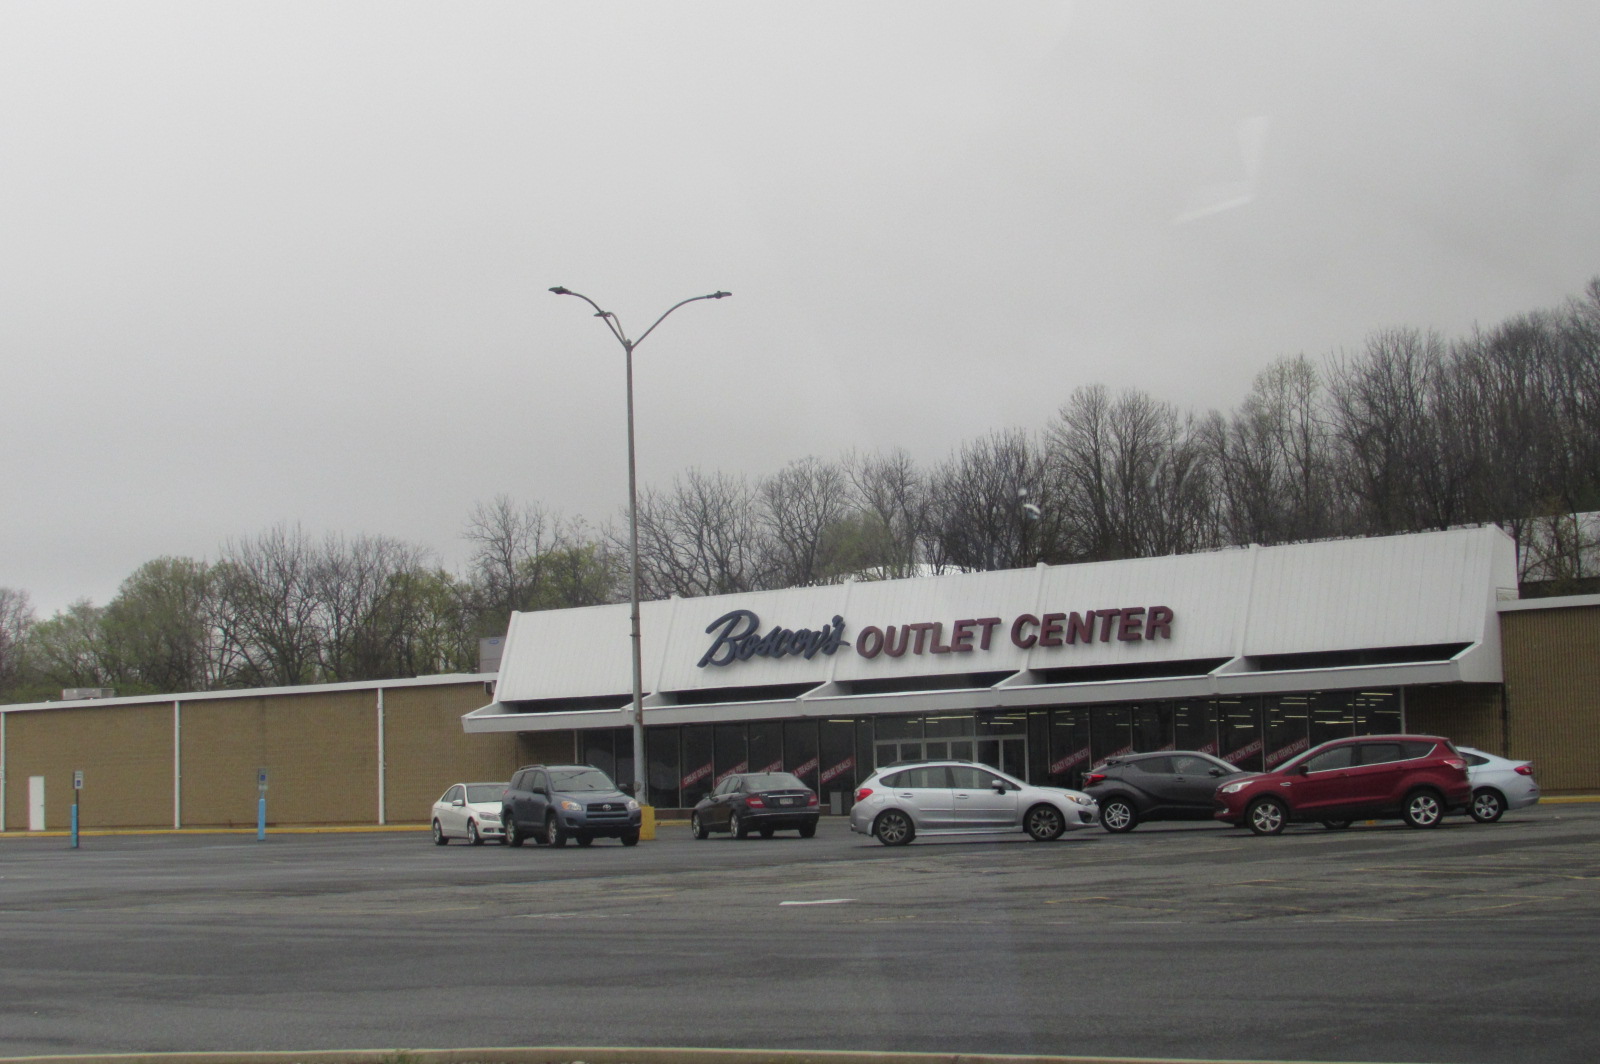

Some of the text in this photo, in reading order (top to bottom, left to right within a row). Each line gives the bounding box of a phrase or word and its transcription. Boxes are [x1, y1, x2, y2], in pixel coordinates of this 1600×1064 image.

[697, 605, 1174, 668] Boscov's OUTLET CENTER
